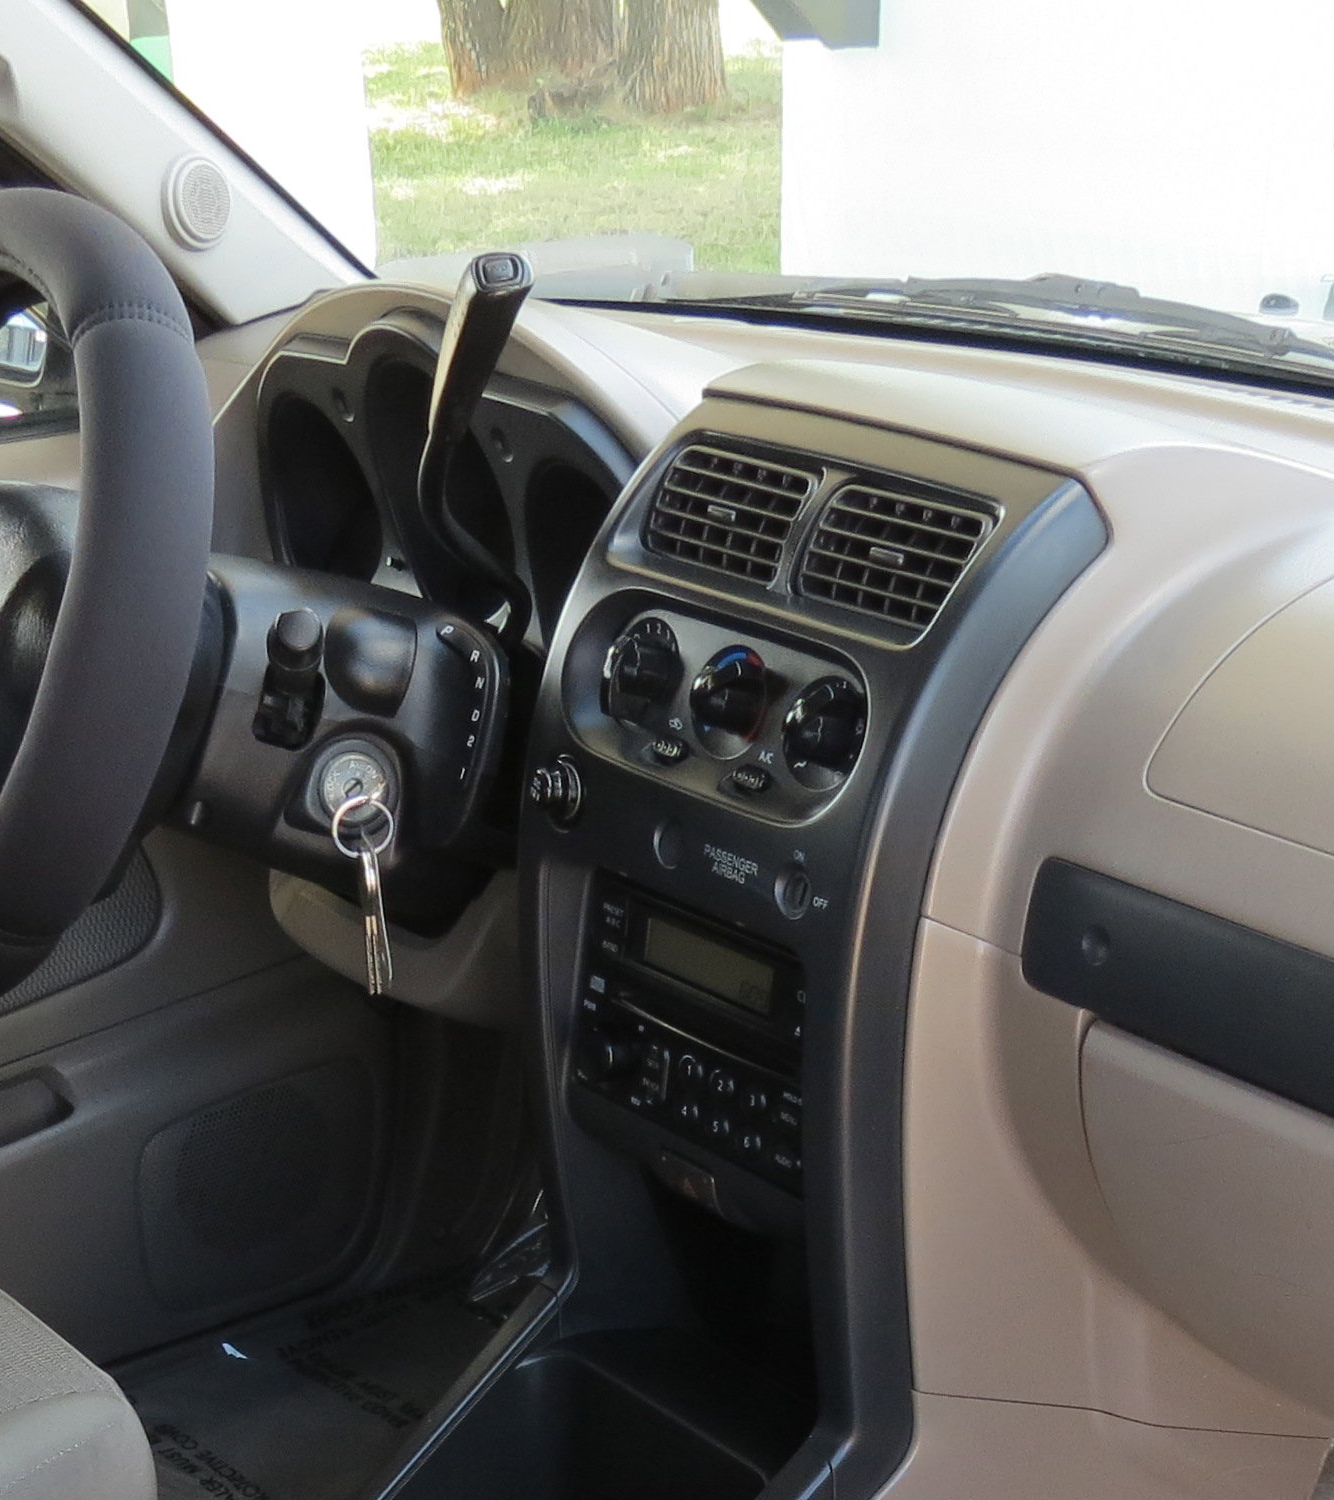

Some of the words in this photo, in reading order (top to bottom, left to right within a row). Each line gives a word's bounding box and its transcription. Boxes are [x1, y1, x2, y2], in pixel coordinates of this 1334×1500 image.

[440, 625, 454, 636] P
[470, 650, 480, 663] R
[475, 676, 485, 689] N
[471, 709, 480, 722] D
[466, 735, 475, 747] 2
[759, 751, 774, 765] A/C
[703, 844, 759, 876] PASSENGER
[711, 861, 746, 884] AIRBAG
[812, 896, 829, 910] OFF
